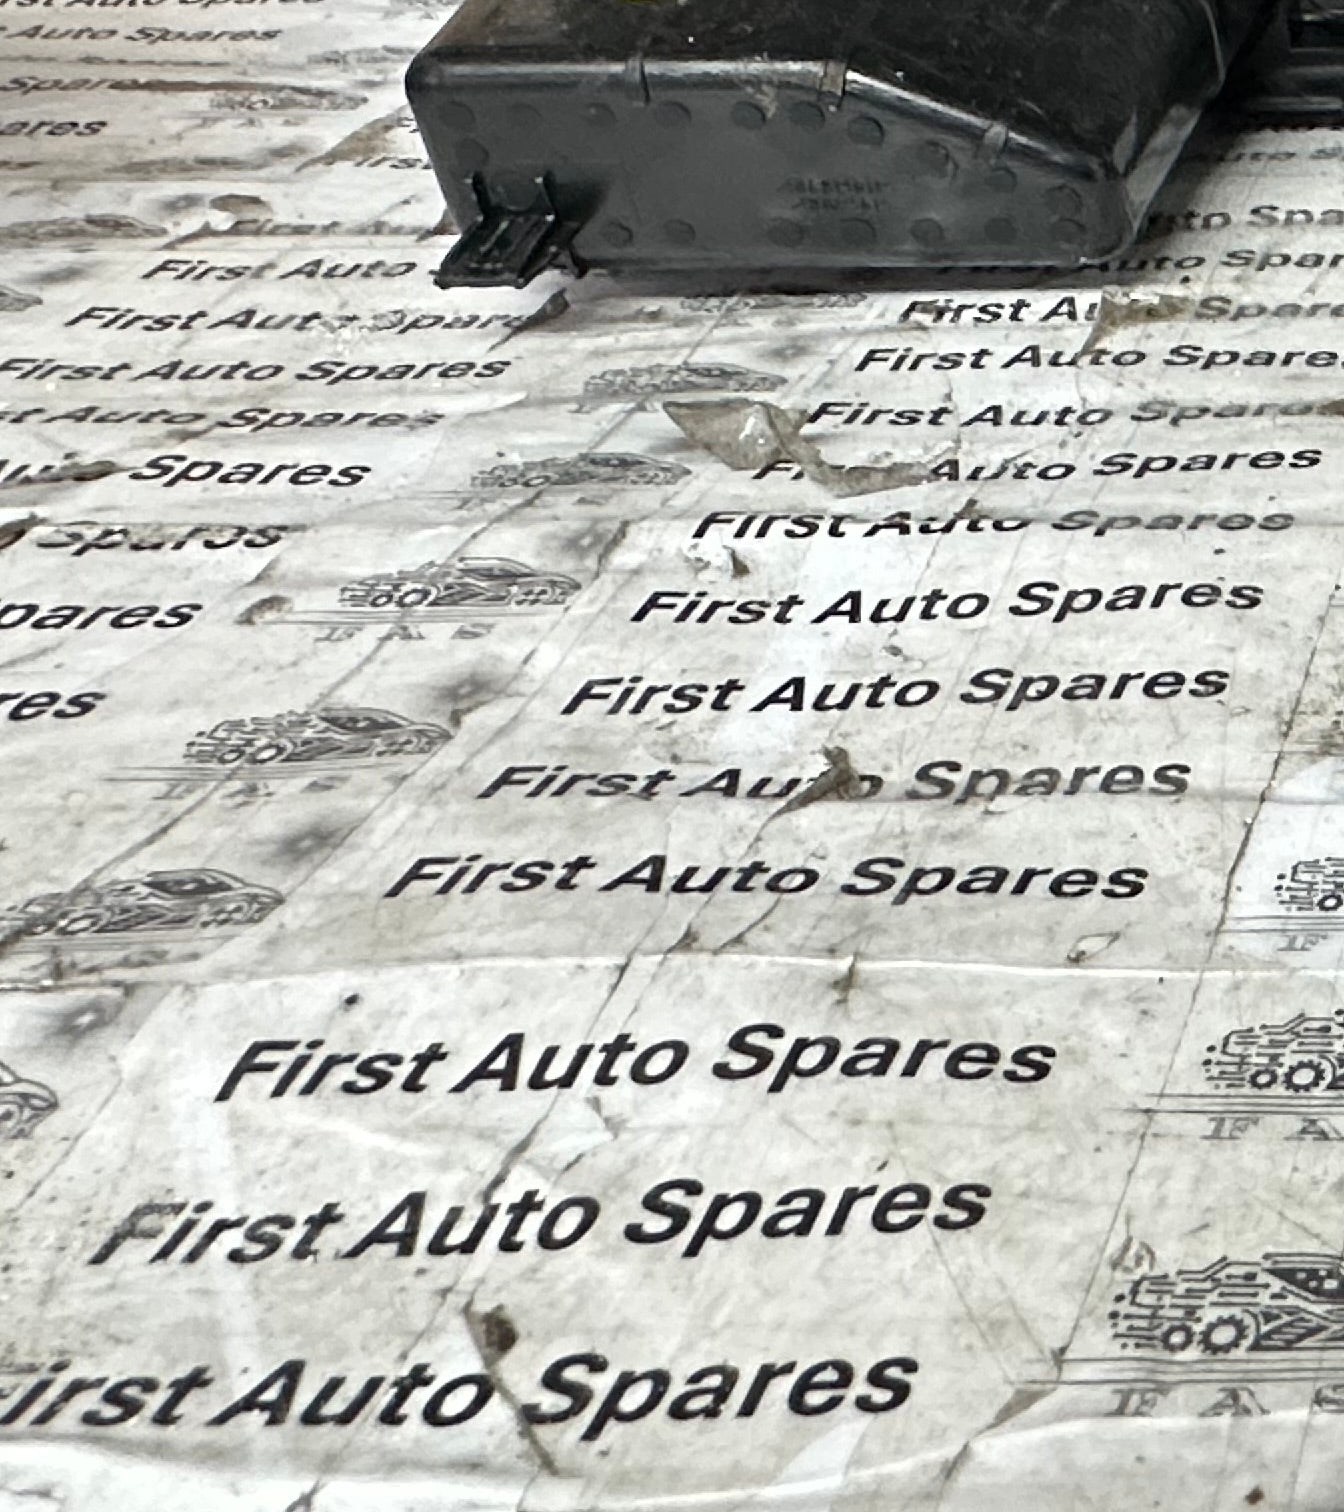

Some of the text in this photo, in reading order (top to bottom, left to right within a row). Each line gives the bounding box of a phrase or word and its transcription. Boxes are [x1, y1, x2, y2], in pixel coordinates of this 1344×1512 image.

[0, 357, 513, 385] First Auto Spares
[630, 582, 1265, 626] First Auto Spares
[561, 667, 1231, 717] First Auto Spares
[214, 1022, 1058, 1102] First Auto Spares
[88, 1177, 992, 1266] First Auto Spares
[206, 1352, 918, 1441] Auto Spares
